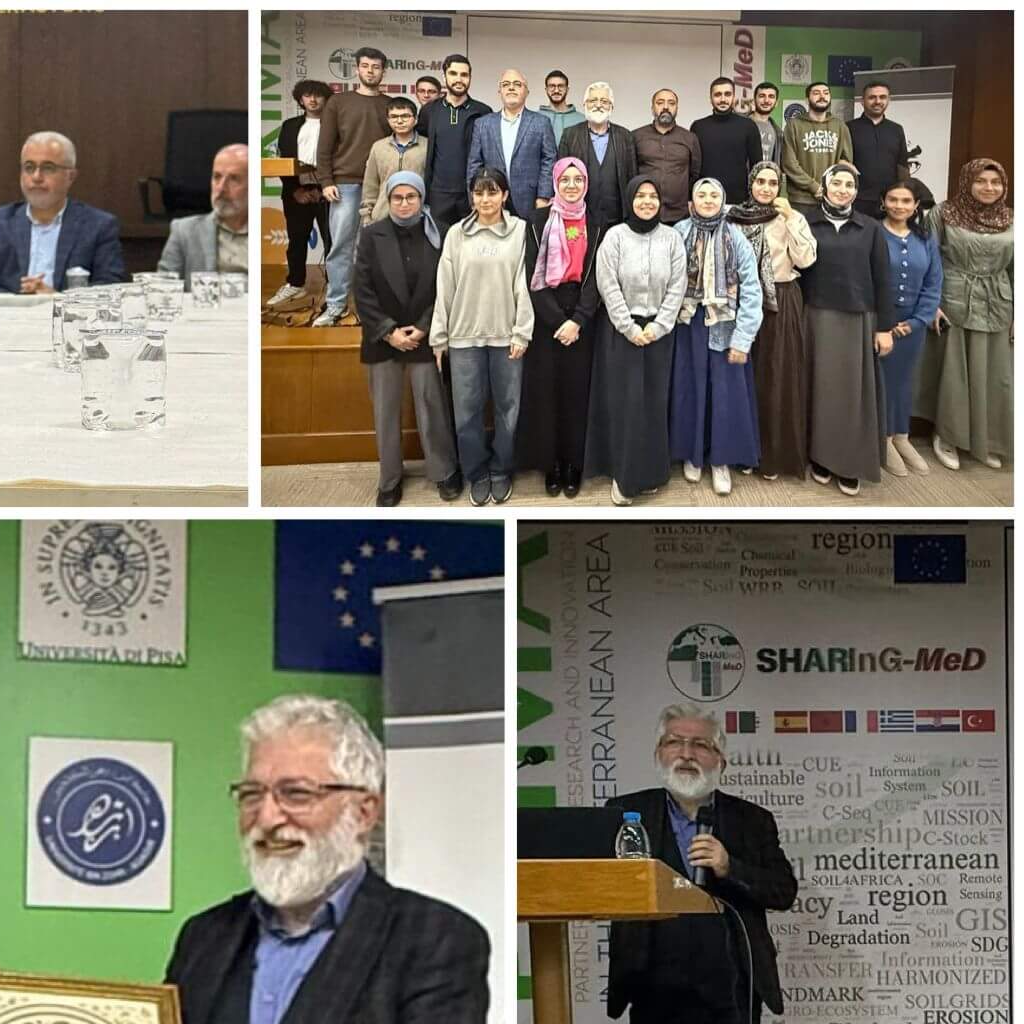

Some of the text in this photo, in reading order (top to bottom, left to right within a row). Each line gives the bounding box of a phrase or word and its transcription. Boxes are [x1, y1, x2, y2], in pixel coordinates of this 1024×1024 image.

[812, 526, 893, 556] region
[741, 548, 796, 561] Chemical
[585, 531, 613, 617] AREA
[739, 565, 798, 581] Properties
[756, 647, 987, 672] SHARInG-MeD
[802, 756, 842, 772] CUE
[869, 767, 941, 777] Information
[816, 773, 863, 799] soil
[883, 781, 927, 792] System
[942, 781, 985, 797] SOIL
[822, 805, 871, 825] C-Seq
[923, 809, 1004, 826] MISSION
[923, 830, 989, 847] C-Stock
[814, 847, 1000, 871] mediterranean
[812, 874, 903, 886] SOIL4AFRICA
[960, 872, 1002, 884] Remote
[868, 883, 947, 912] region
[960, 888, 1002, 900] Sensing
[838, 909, 879, 925] Land
[956, 908, 1007, 931] GIS
[915, 922, 948, 938] Soil
[808, 930, 910, 948] Degradation
[972, 936, 1008, 952] SDG
[882, 951, 984, 967] Information
[877, 969, 1006, 986] HARMONIZED
[905, 993, 1008, 1009] SOILGRIDS
[924, 1009, 1008, 1024] EROSION
